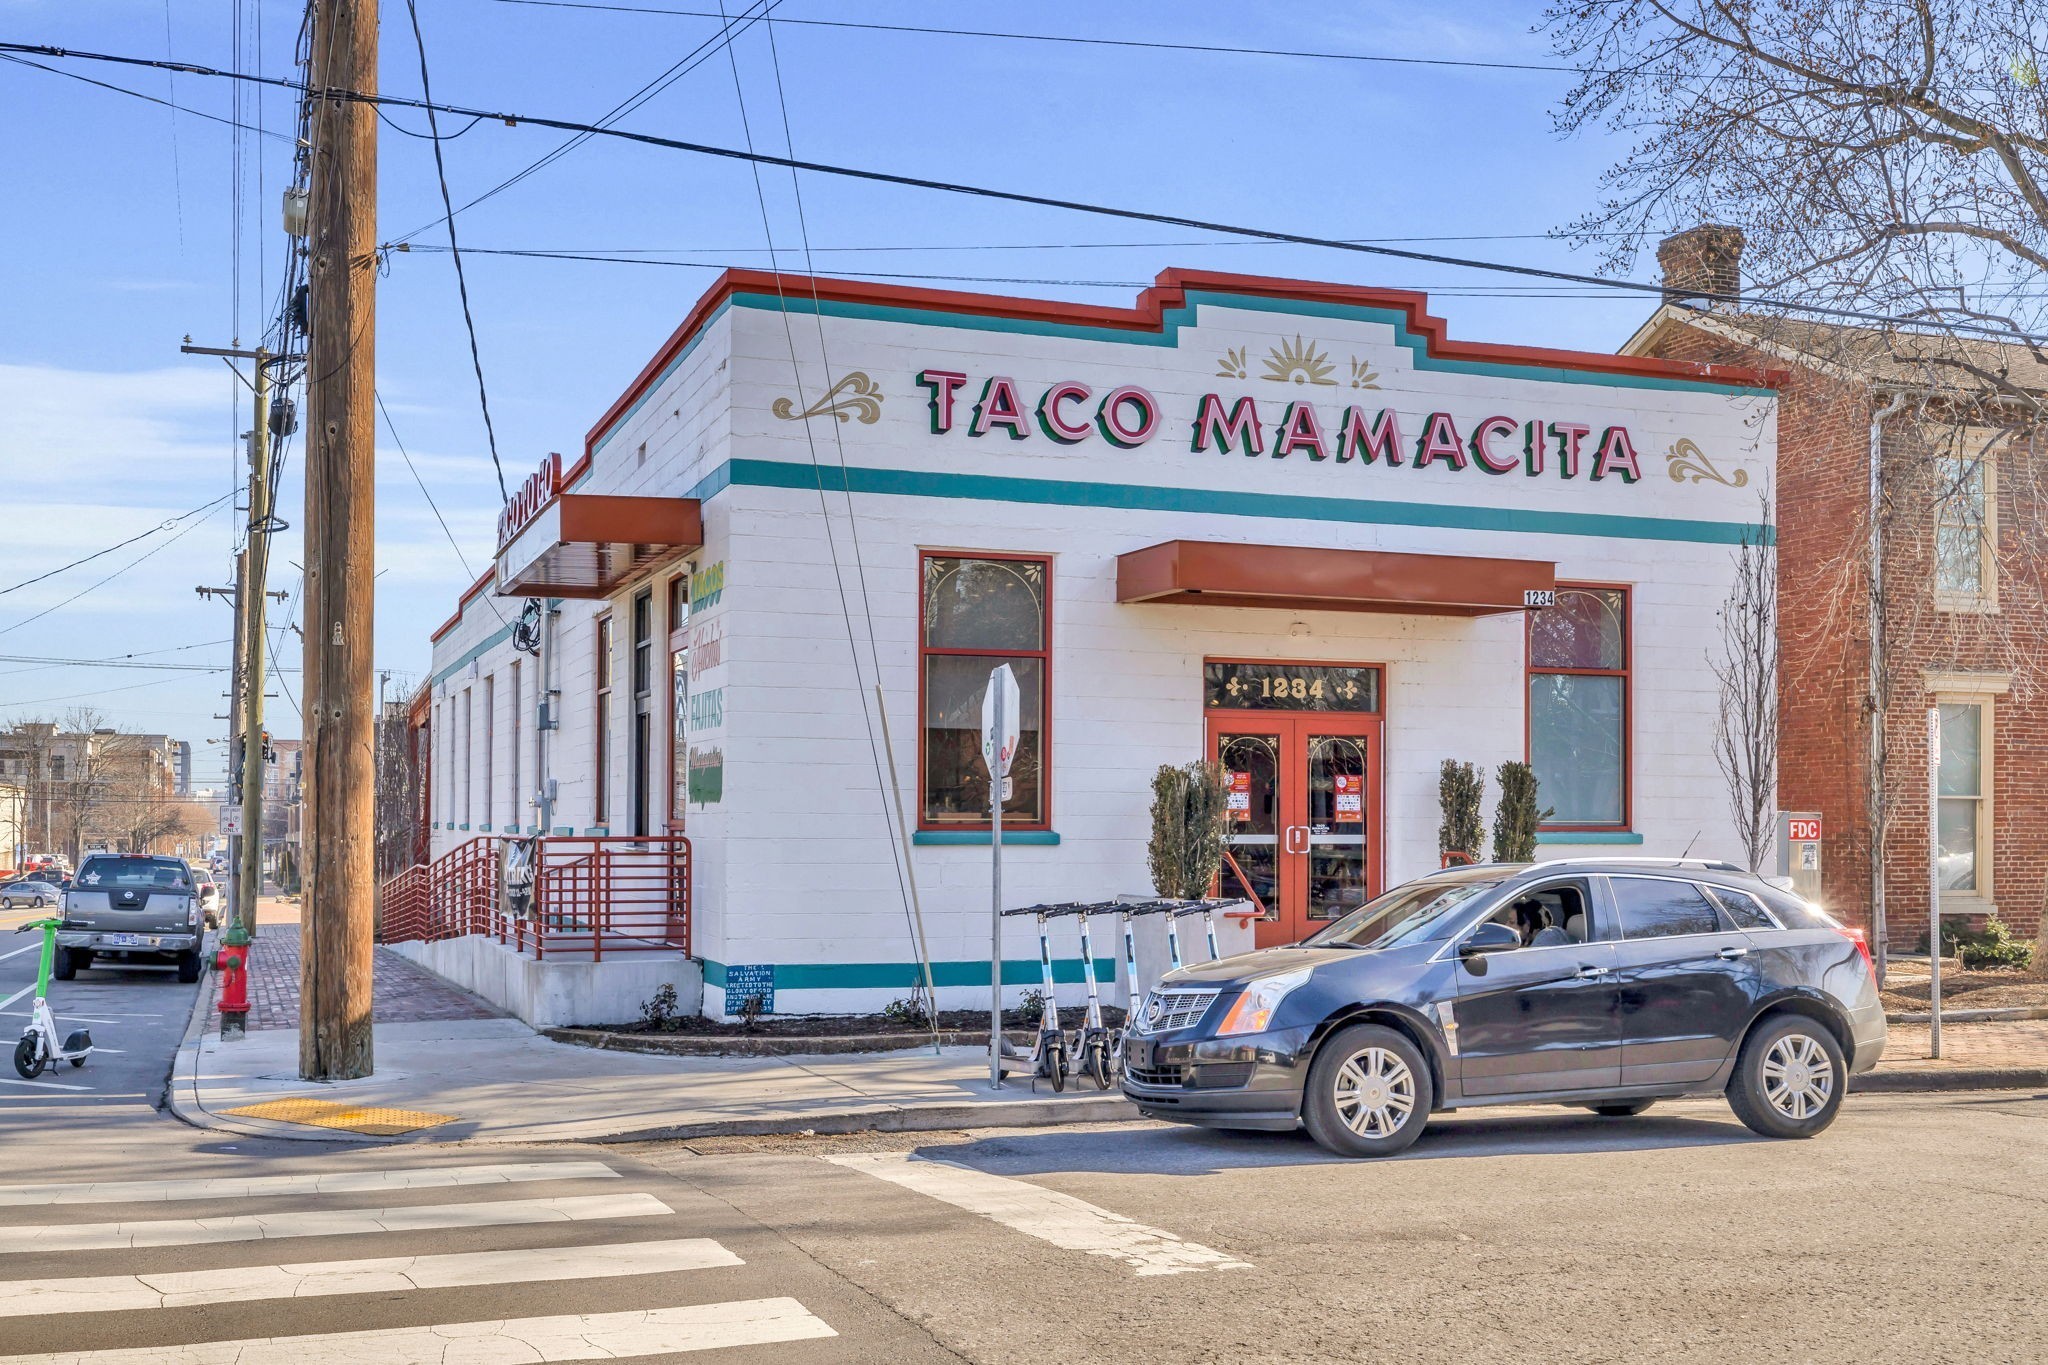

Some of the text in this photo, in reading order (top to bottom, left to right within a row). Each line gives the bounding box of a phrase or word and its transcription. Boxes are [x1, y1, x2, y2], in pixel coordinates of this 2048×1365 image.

[916, 369, 1642, 484] TACO MAMACITA
[691, 560, 724, 614] TACOS
[1526, 591, 1554, 606] 1234
[1261, 677, 1324, 699] 1234
[691, 687, 723, 731] FAJITAS
[1790, 821, 1817, 838] FDC
